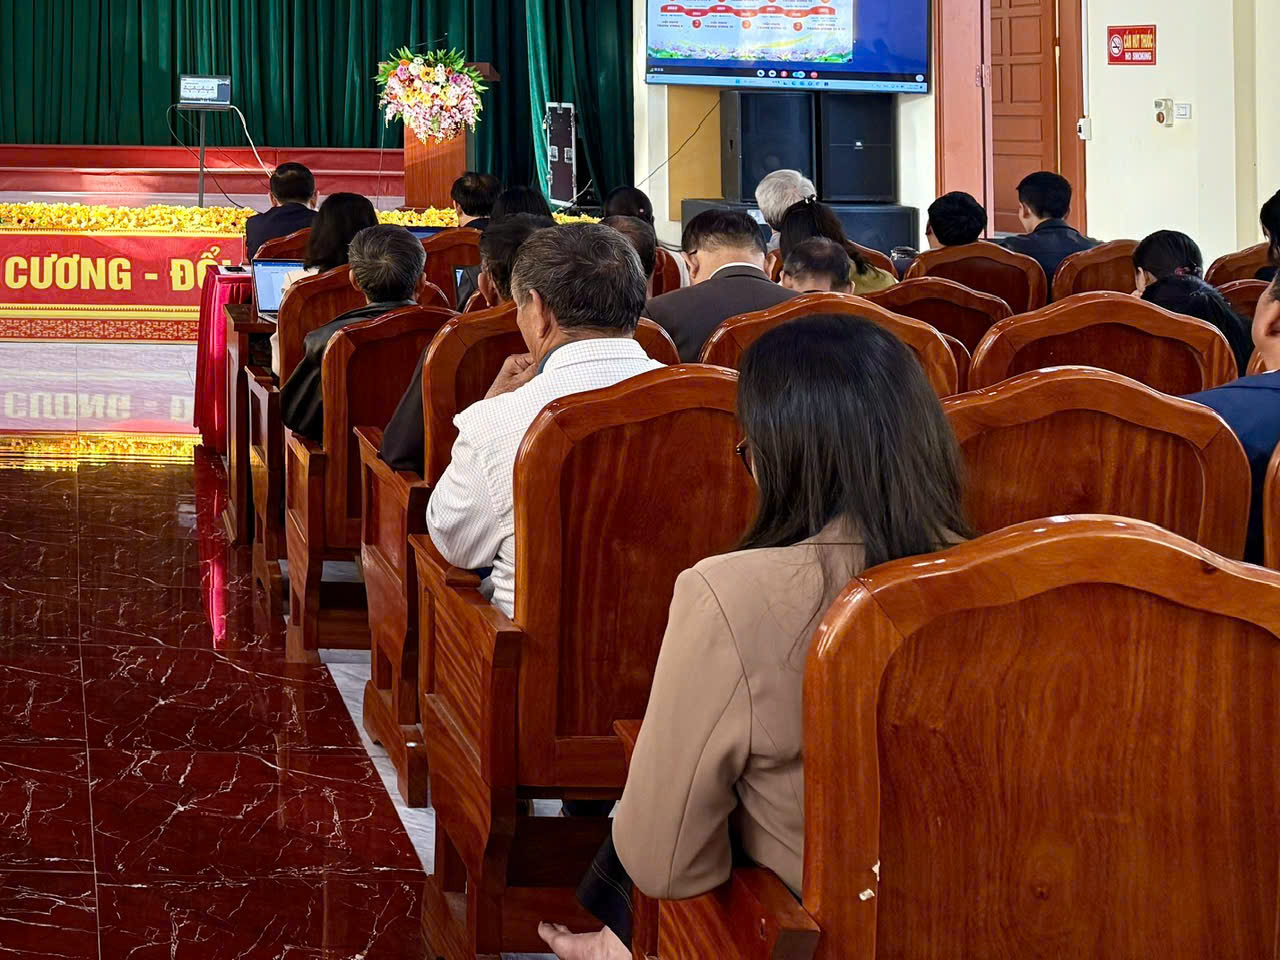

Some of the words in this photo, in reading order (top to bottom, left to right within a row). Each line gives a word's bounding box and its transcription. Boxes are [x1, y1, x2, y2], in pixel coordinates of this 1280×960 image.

[1125, 51, 1131, 61] NO
[1132, 51, 1152, 61] SMOKING
[4, 252, 132, 291] CƯƠNG
[169, 245, 232, 291] ĐỔ
